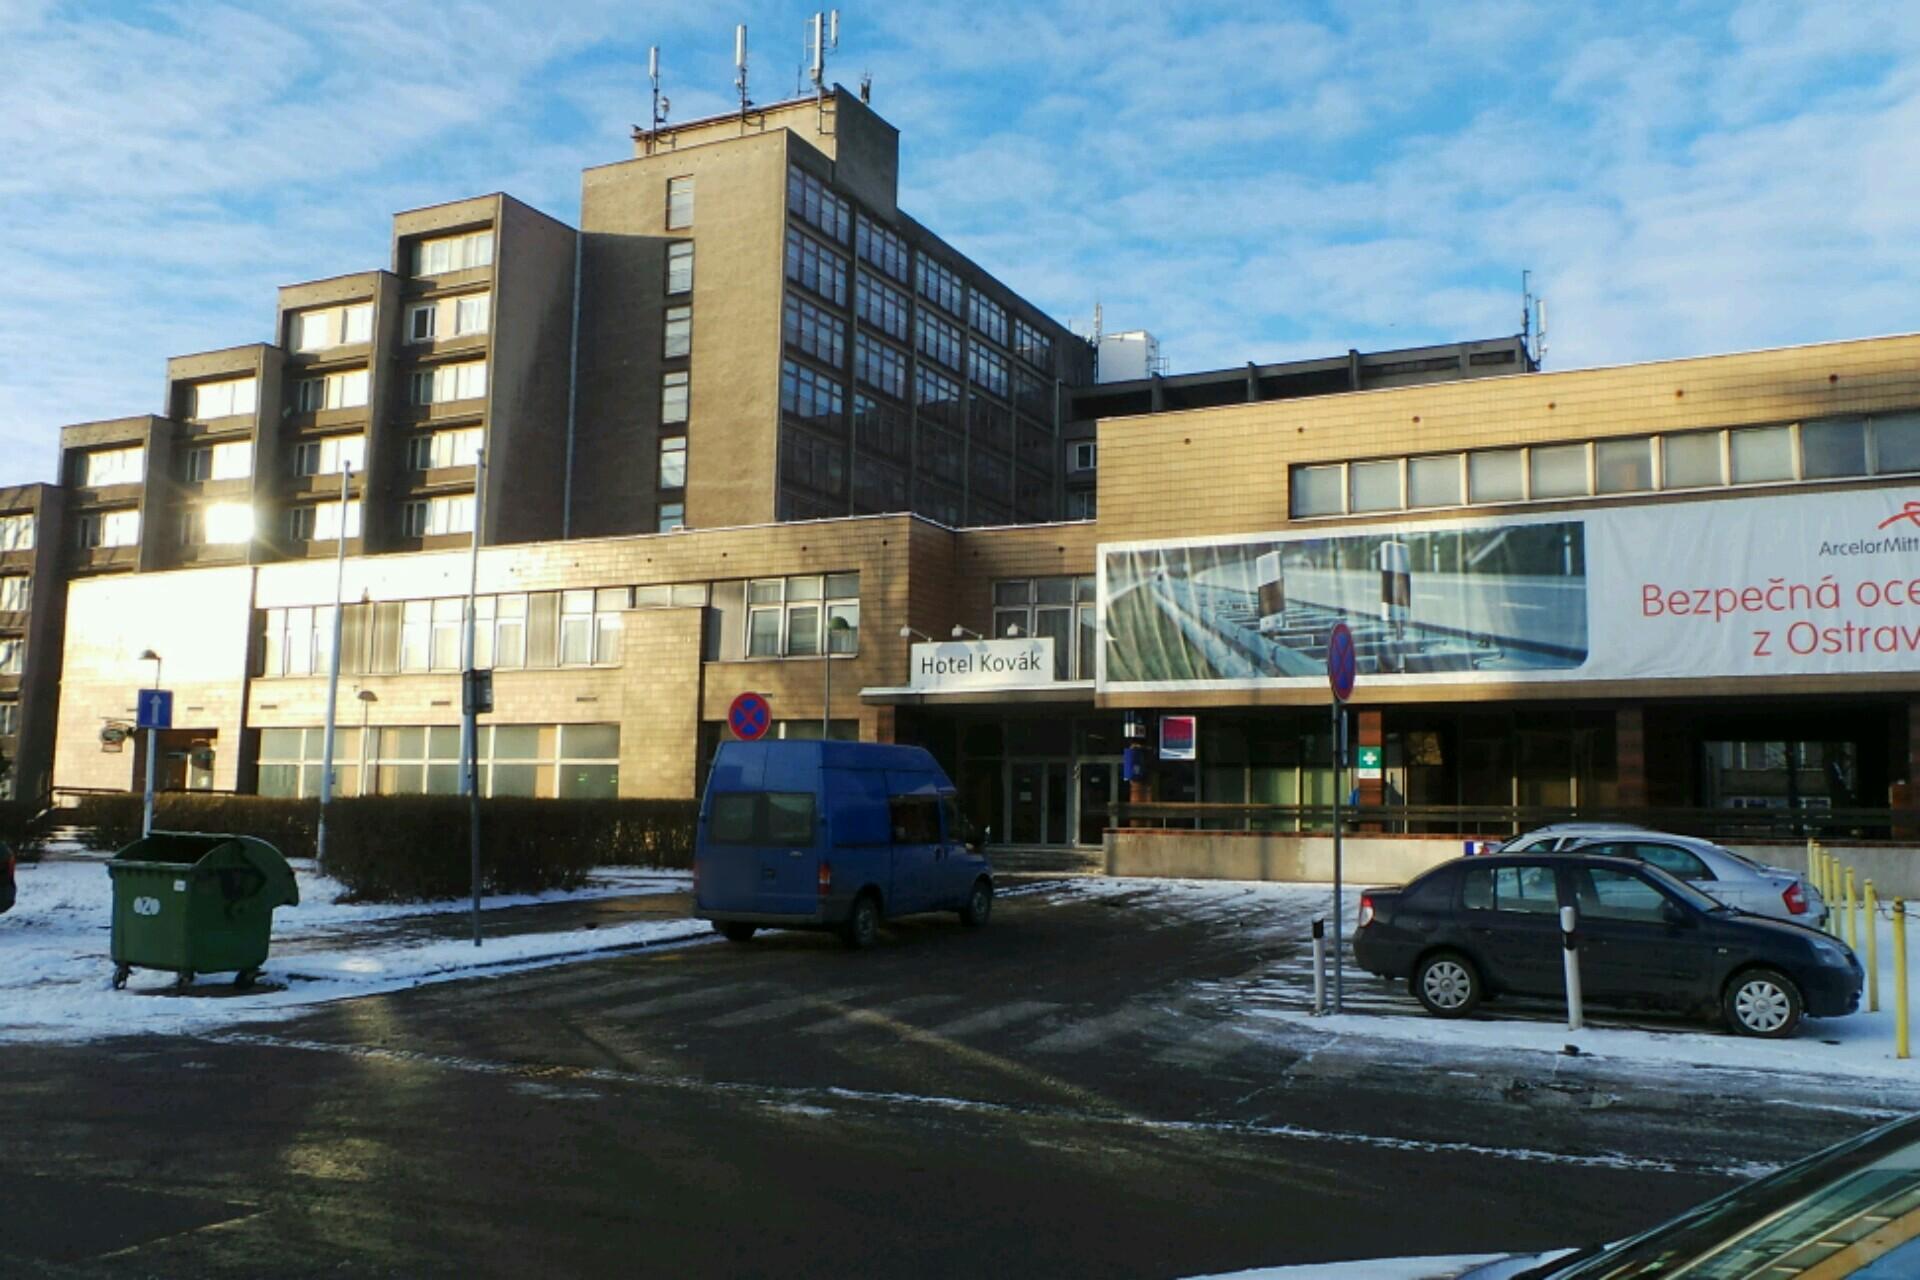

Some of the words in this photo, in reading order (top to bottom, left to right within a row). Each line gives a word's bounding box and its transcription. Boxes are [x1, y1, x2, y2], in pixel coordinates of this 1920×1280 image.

[1818, 536, 1920, 556] ArcelorMitt
[1642, 575, 1840, 622] Bezpečná
[1752, 630, 1772, 656] z
[1786, 619, 1920, 655] Ostrav
[921, 653, 973, 674] Hotel
[980, 649, 1041, 673] Kovák
